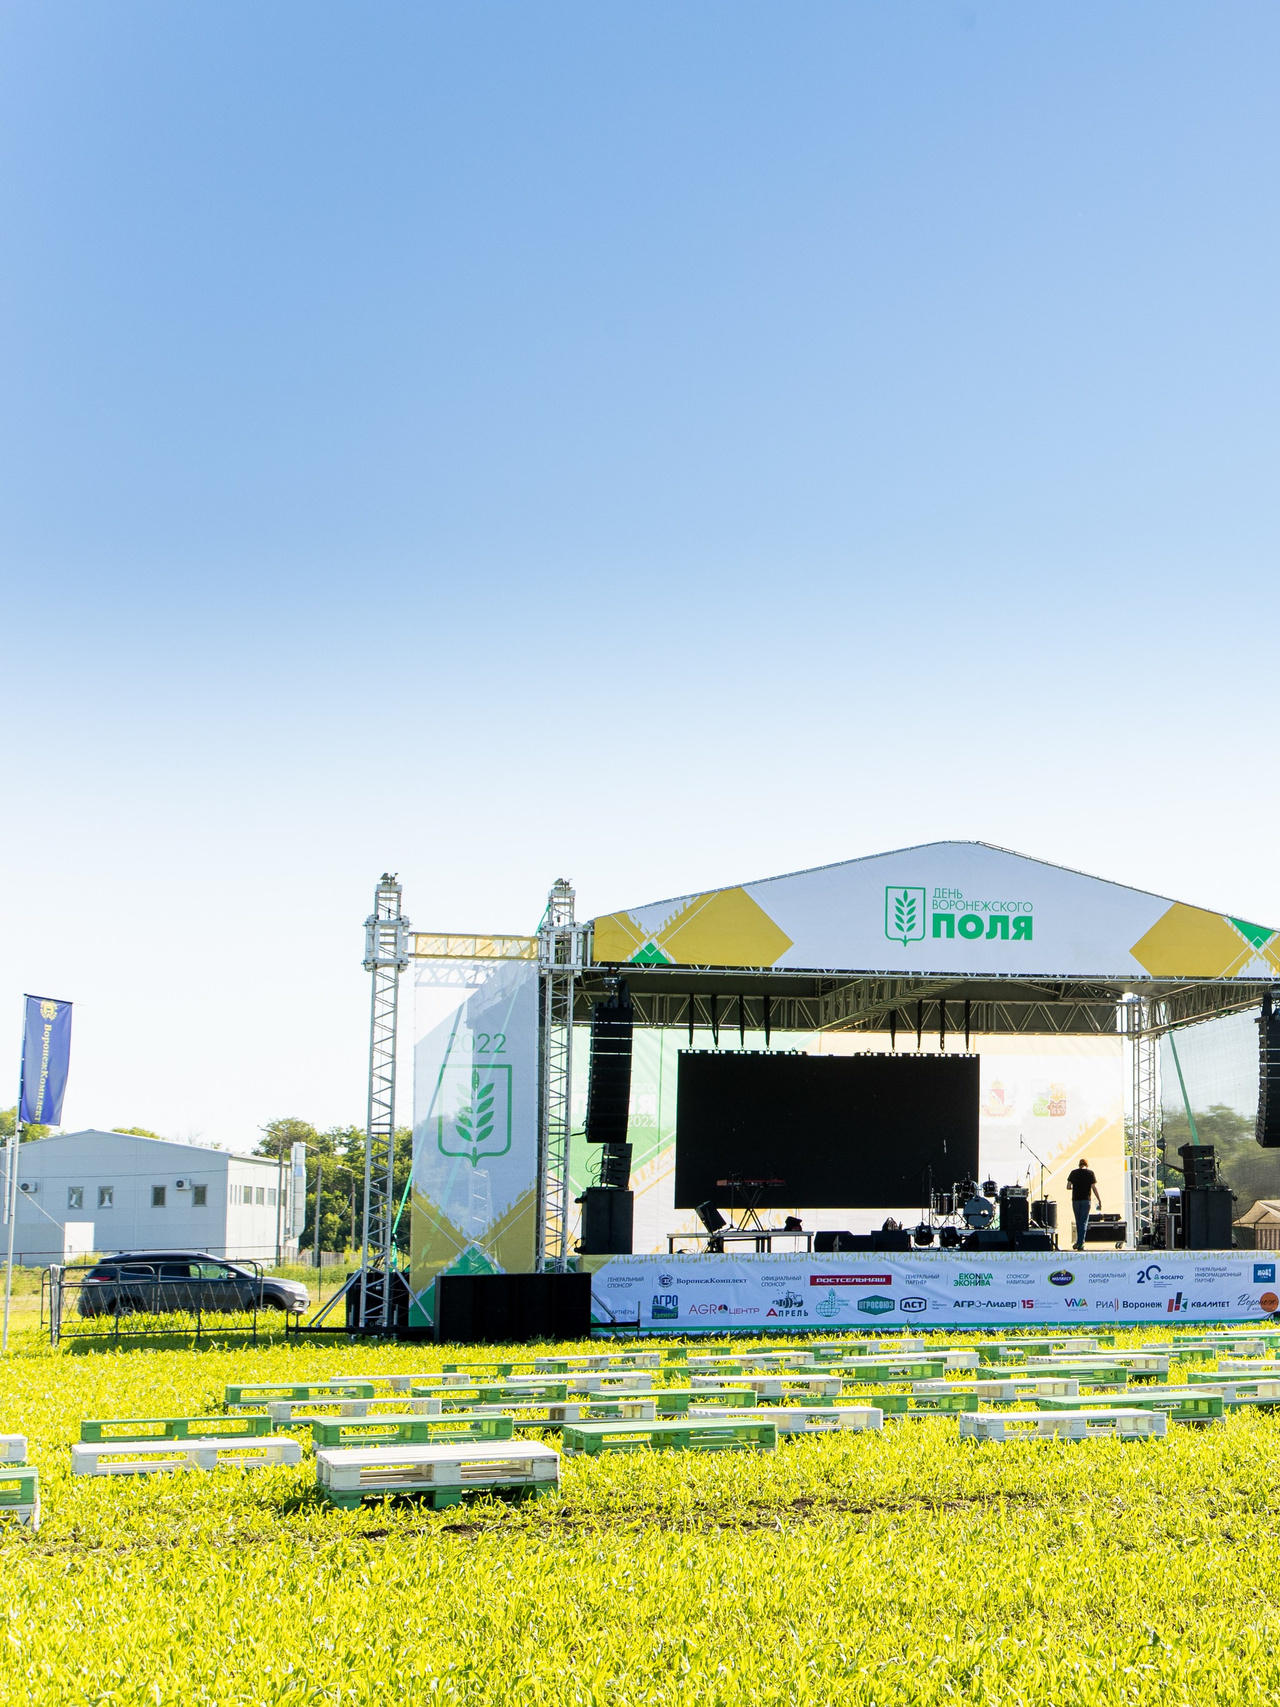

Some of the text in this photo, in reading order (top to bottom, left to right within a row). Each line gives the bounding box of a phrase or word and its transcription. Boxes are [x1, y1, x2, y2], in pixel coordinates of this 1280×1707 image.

[932, 887, 963, 899] ДЕНЬ
[932, 899, 1034, 913] ВОРОНЕЖСКОГО
[932, 913, 1033, 940] ПОЛЯ
[447, 1033, 507, 1054] 2022
[652, 1294, 679, 1307] АГРО
[1021, 1299, 1034, 1309] 15
[1122, 1300, 1163, 1310] Воронеж
